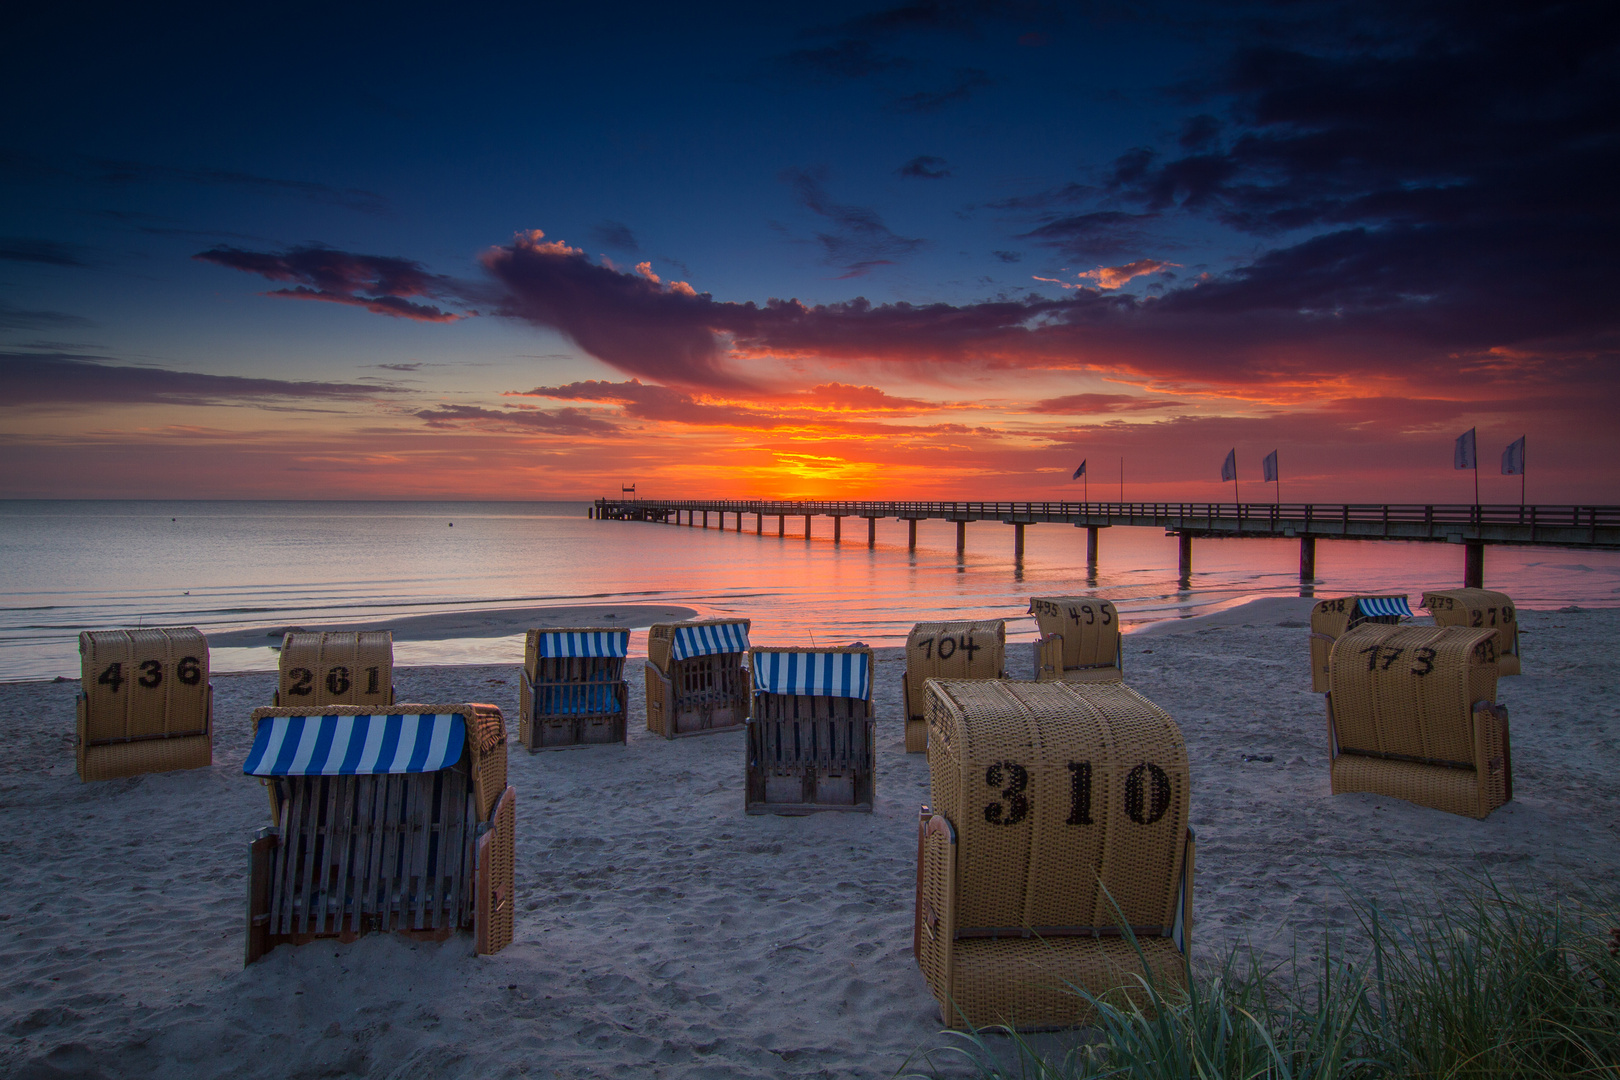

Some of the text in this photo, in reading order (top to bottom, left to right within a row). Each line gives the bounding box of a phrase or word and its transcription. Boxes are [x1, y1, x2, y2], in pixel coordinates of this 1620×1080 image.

[1068, 603, 1112, 626] 495
[1471, 606, 1513, 628] 279
[98, 656, 201, 692] 436
[1358, 644, 1437, 676] 173
[288, 666, 380, 696] 261
[983, 760, 1172, 826] 310
